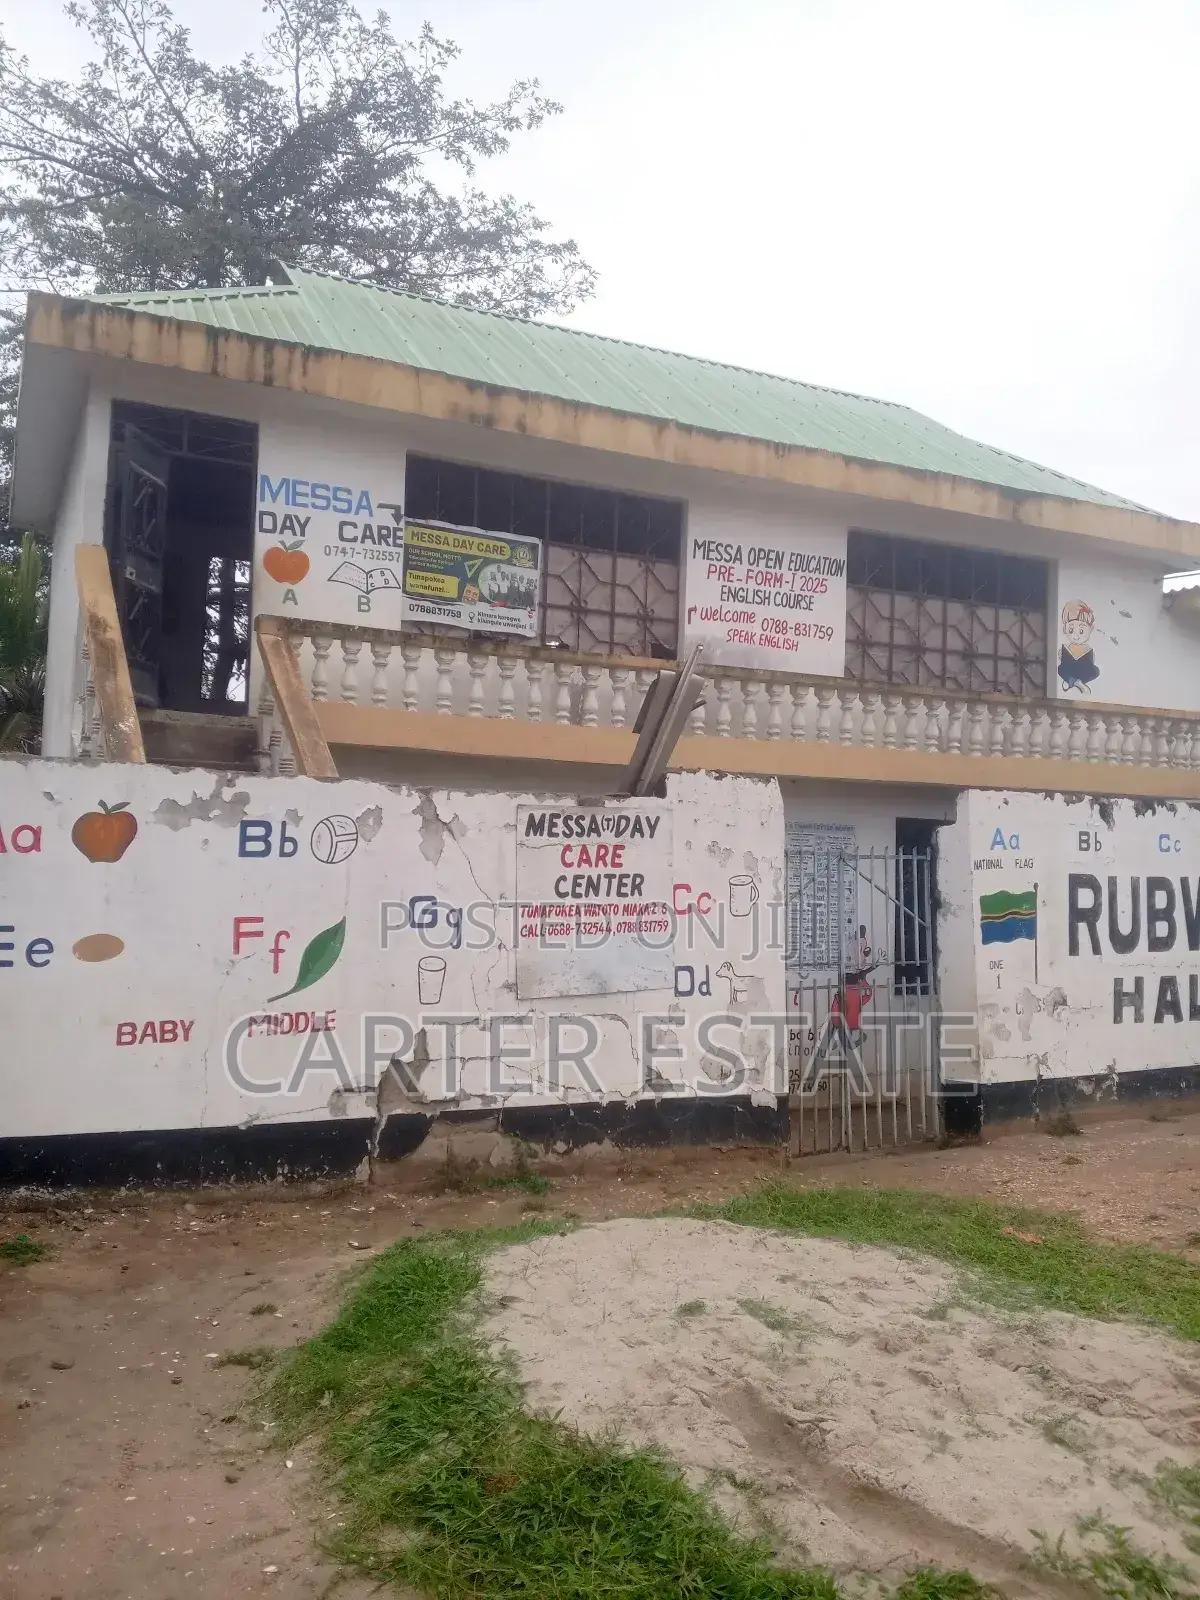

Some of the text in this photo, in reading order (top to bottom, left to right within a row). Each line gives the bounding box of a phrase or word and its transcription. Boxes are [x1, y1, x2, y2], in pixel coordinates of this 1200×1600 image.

[259, 474, 374, 517] MESSA
[258, 510, 404, 549] DAY CARE
[324, 544, 401, 563] 0747-732557
[410, 530, 507, 557] MESSA DAY CARE
[420, 550, 441, 558] SCHOOL
[692, 538, 846, 578] MESSA OPEN EDUCATION
[408, 572, 446, 585] Tunapokea
[799, 575, 829, 594] 2025
[282, 588, 299, 606] A
[357, 594, 371, 613] B
[720, 584, 815, 612] ENGLISH COURSE
[408, 603, 462, 619] 0788831759
[477, 611, 497, 620] Kimara
[700, 604, 834, 642] Welcome 0788-831759
[726, 628, 800, 653] SPEAK ENGLISH
[237, 819, 299, 858] Bb
[990, 828, 1021, 851] Aa
[1078, 831, 1102, 852] Bb
[1158, 833, 1182, 853] Cc
[560, 844, 626, 869] CARE
[973, 858, 1034, 871] NATIONAL FLAG
[554, 873, 645, 899] CENTER
[520, 904, 582, 919] TUNAPOKEA
[583, 903, 620, 918] WATOTO
[672, 883, 712, 916] Cc
[408, 895, 463, 950] Gg
[232, 916, 291, 975] Ff
[989, 960, 1004, 971] ONE
[674, 964, 712, 998] Dd
[115, 1020, 195, 1046] BABY
[246, 1010, 337, 1037] MIDDLE
